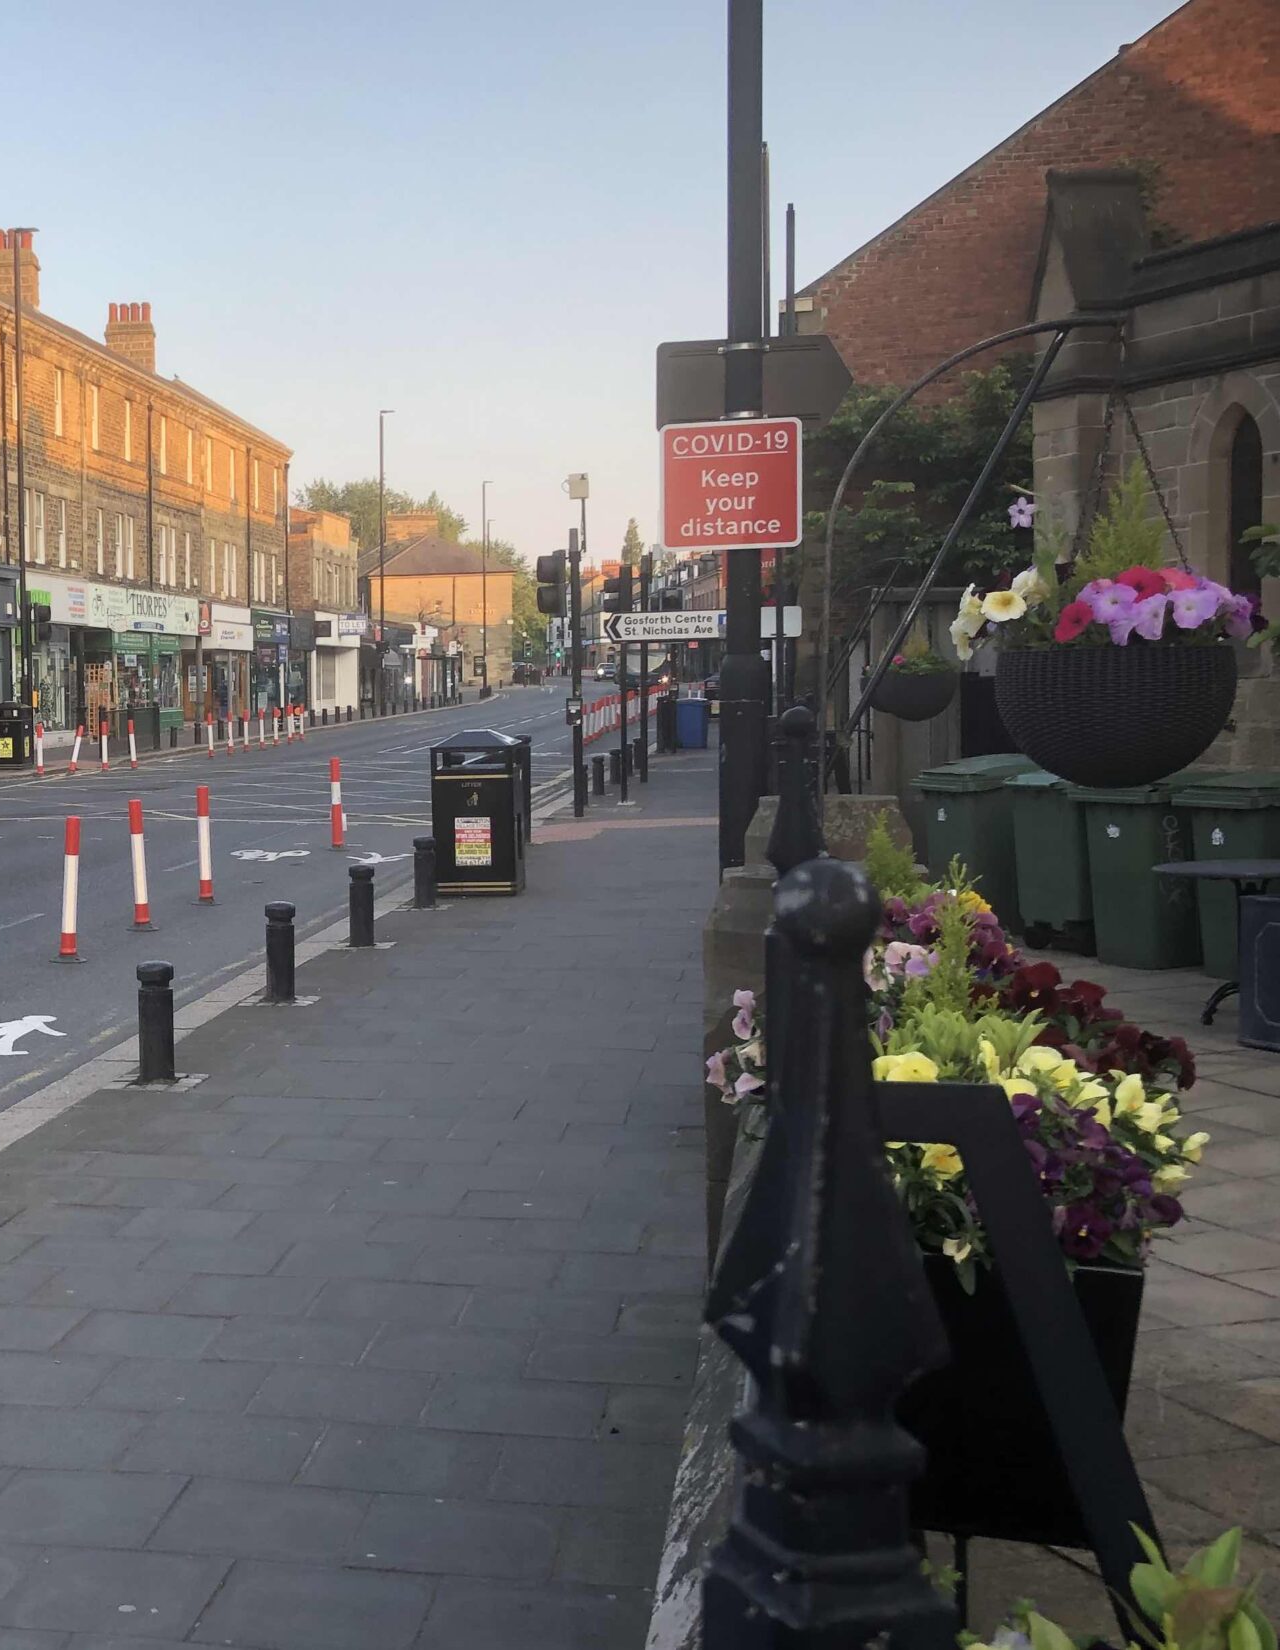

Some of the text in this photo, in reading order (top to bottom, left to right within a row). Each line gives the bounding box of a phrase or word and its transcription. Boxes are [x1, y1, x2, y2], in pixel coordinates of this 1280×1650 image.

[672, 430, 789, 455] COVID-19
[701, 469, 759, 489] Keep
[705, 496, 756, 515] your
[681, 517, 781, 536] distance
[129, 593, 168, 618] THORPES
[624, 615, 712, 625] Gosforth Centre
[624, 625, 713, 636] St. Nicholas Ave
